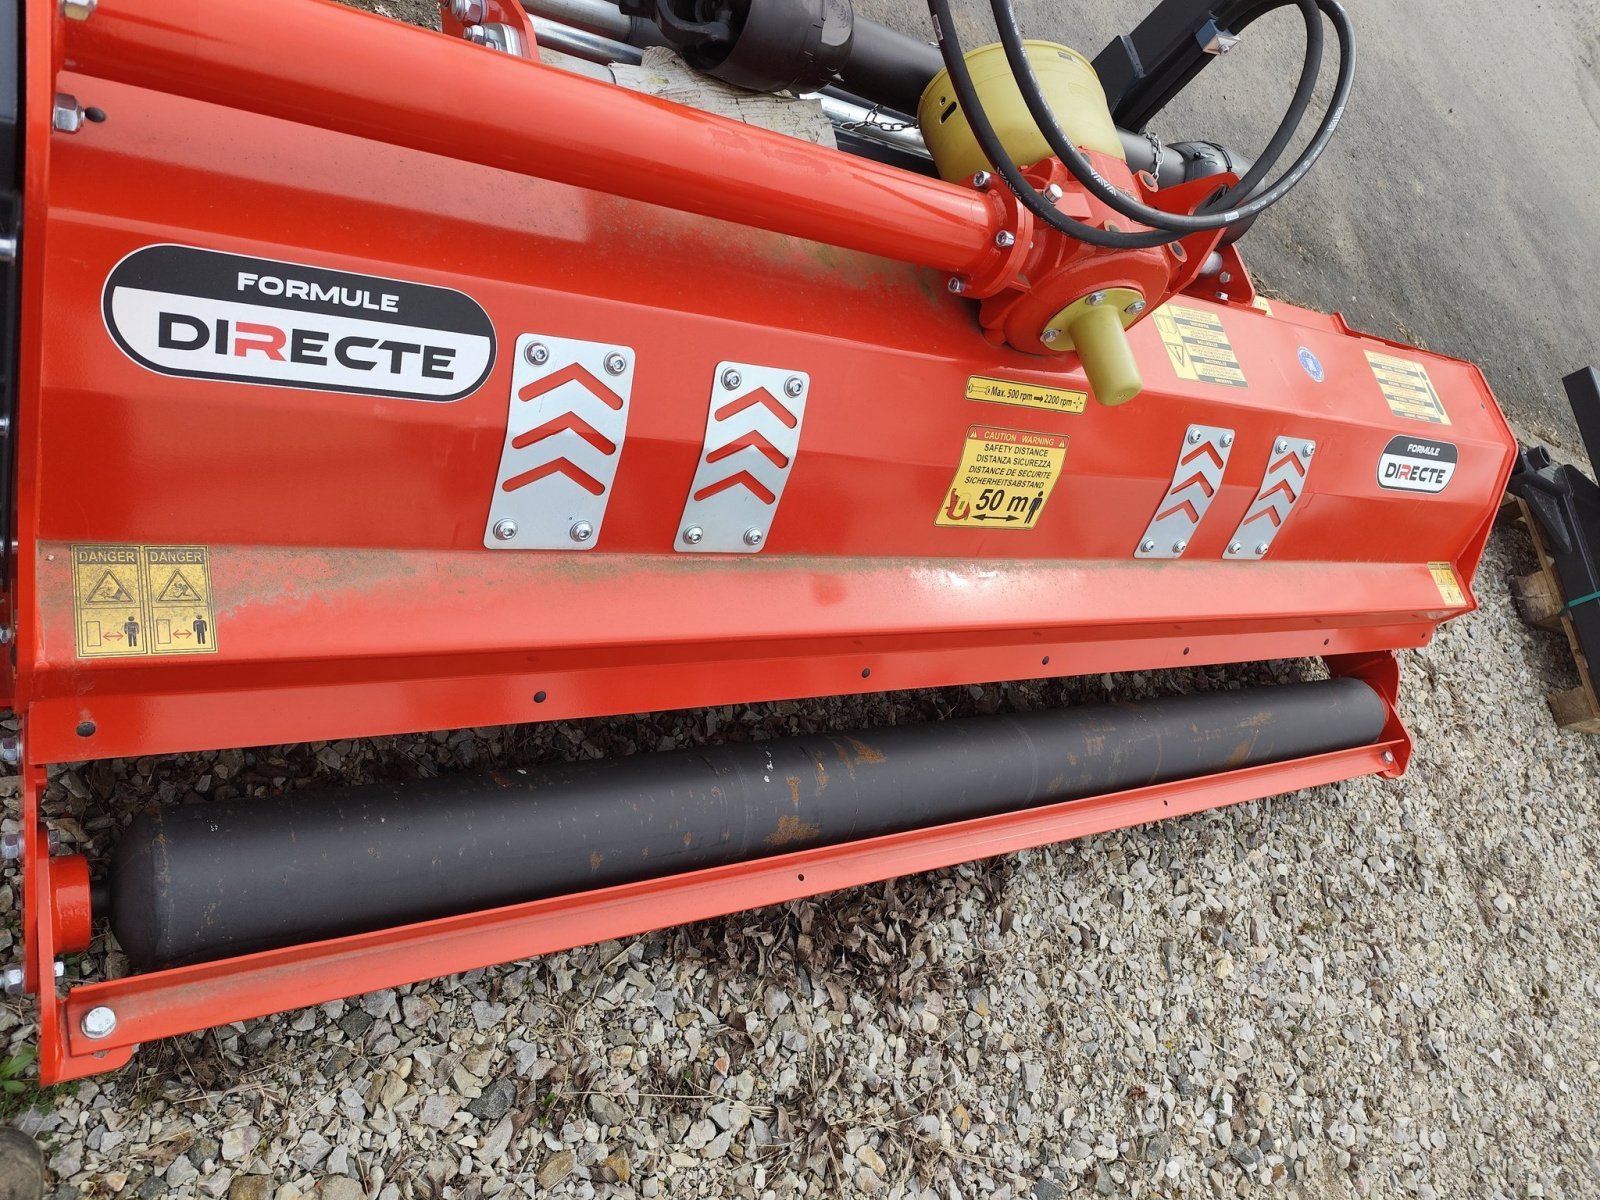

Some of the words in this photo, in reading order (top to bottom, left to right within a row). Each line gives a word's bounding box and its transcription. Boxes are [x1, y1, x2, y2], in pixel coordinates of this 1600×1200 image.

[237, 272, 400, 313] FORMULE
[158, 311, 457, 380] DIRECTE
[990, 387, 1006, 397] Max.
[1007, 389, 1019, 399] 500
[1019, 393, 1033, 402] rpm
[1043, 394, 1060, 404] 2200
[1060, 397, 1073, 407] rpm
[984, 431, 1017, 441] CAUTION
[1021, 435, 1054, 446] WARNING
[984, 443, 1012, 453] SAFETY
[1014, 446, 1048, 457] DISTANCE
[1407, 444, 1440, 456] FORMULE
[976, 454, 1011, 465] DISTANZA
[1013, 458, 1051, 468] SICUREZZA
[968, 465, 1005, 475] DISTANCE
[1005, 468, 1016, 477] DE
[1017, 469, 1052, 479] SECURITE
[1384, 462, 1446, 484] DIRECTE
[964, 476, 1045, 488] SICHERHEITSABSTAND
[976, 488, 1005, 511] 50
[1006, 496, 1029, 512] m
[79, 552, 135, 562] DANGER
[150, 552, 202, 562] DANGER
